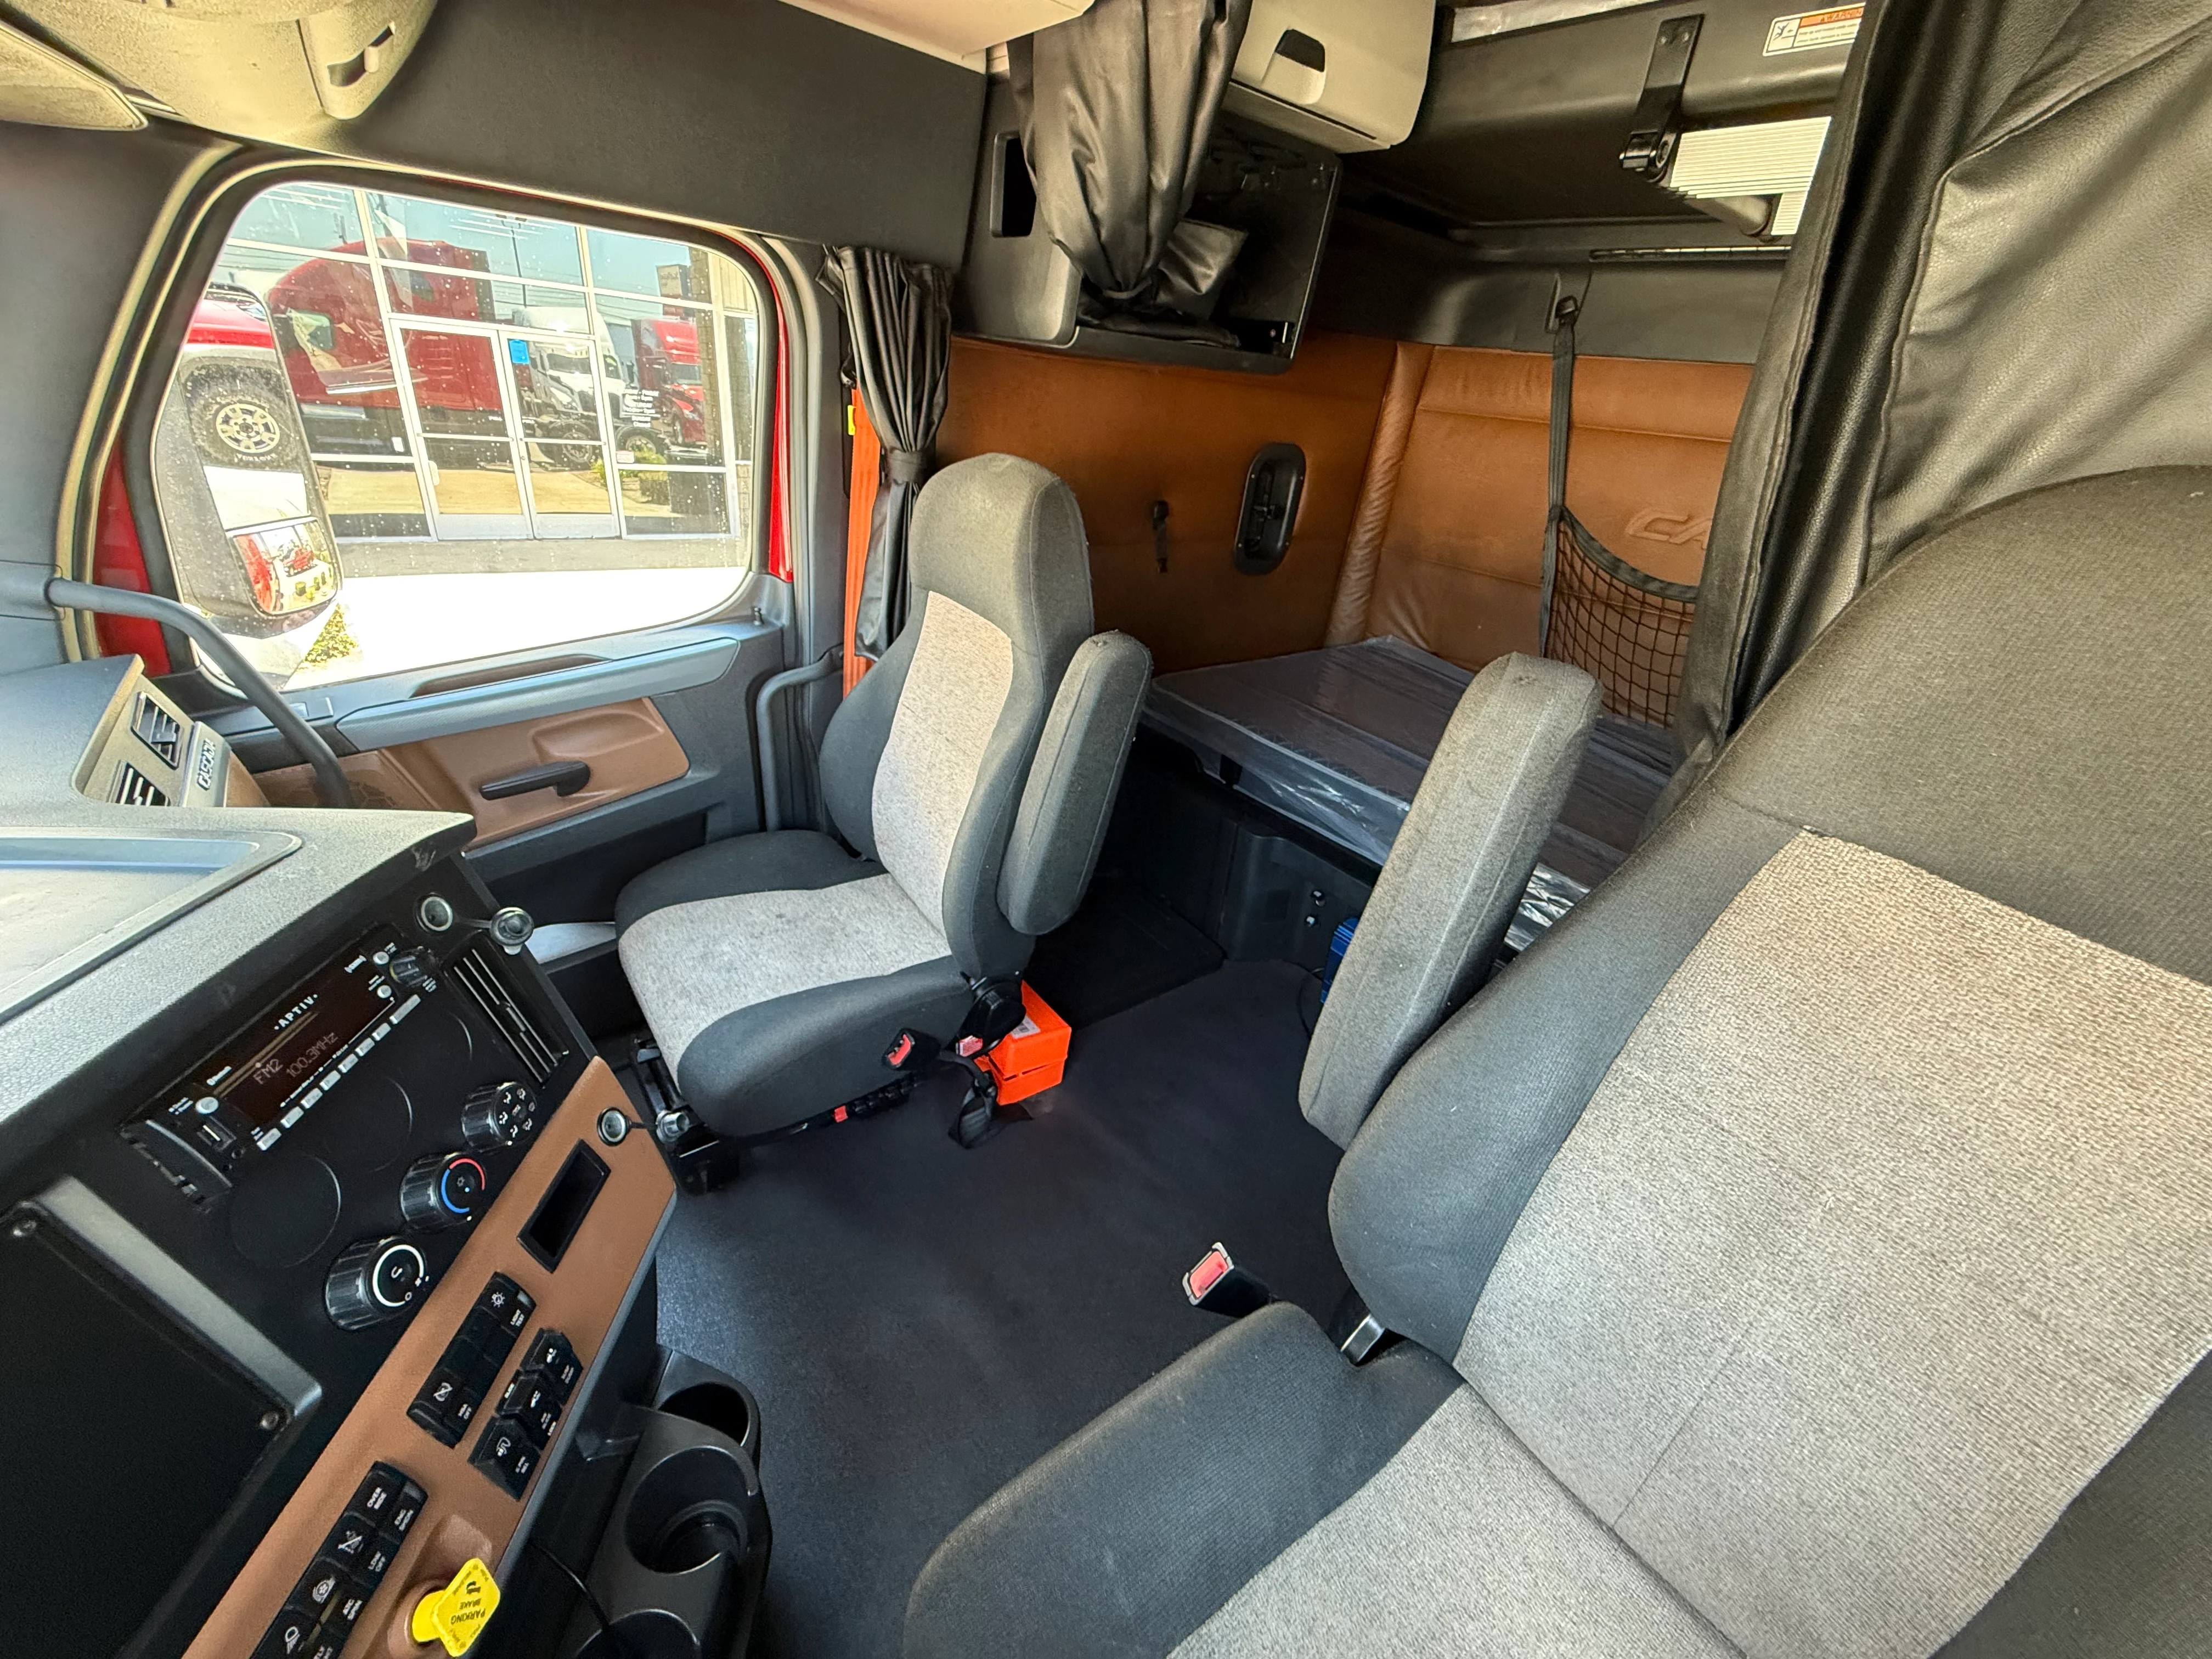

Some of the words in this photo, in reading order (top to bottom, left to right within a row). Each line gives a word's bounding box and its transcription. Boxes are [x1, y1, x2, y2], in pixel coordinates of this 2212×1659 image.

[278, 996, 315, 1028] APTIV
[286, 1032, 339, 1078] 100.3MHz
[252, 1058, 283, 1085] FM2
[367, 1487, 382, 1508] OVER
[375, 1556, 386, 1572] OFF
[459, 1598, 481, 1610] BRAKE
[450, 1608, 486, 1625] PARKING
